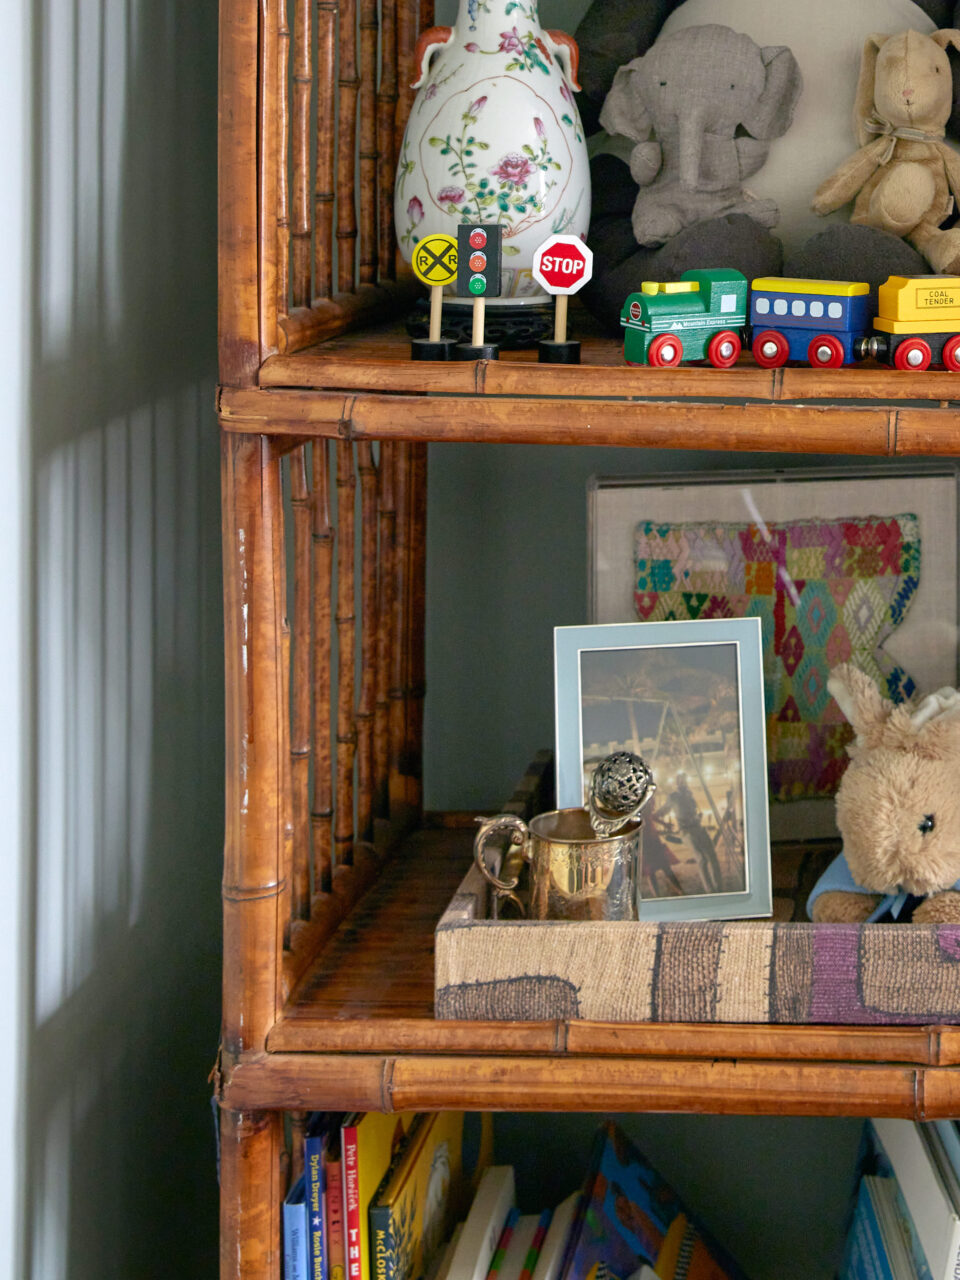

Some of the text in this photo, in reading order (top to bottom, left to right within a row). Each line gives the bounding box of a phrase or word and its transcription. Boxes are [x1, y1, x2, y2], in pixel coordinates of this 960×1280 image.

[541, 255, 584, 275] STOP
[929, 290, 949, 298] COAL
[347, 1144, 357, 1166] Petr
[310, 1154, 320, 1182] Dylan
[310, 1182, 321, 1212] Dreyer
[313, 1231, 322, 1256] Rosie
[349, 1228, 360, 1277] THE
